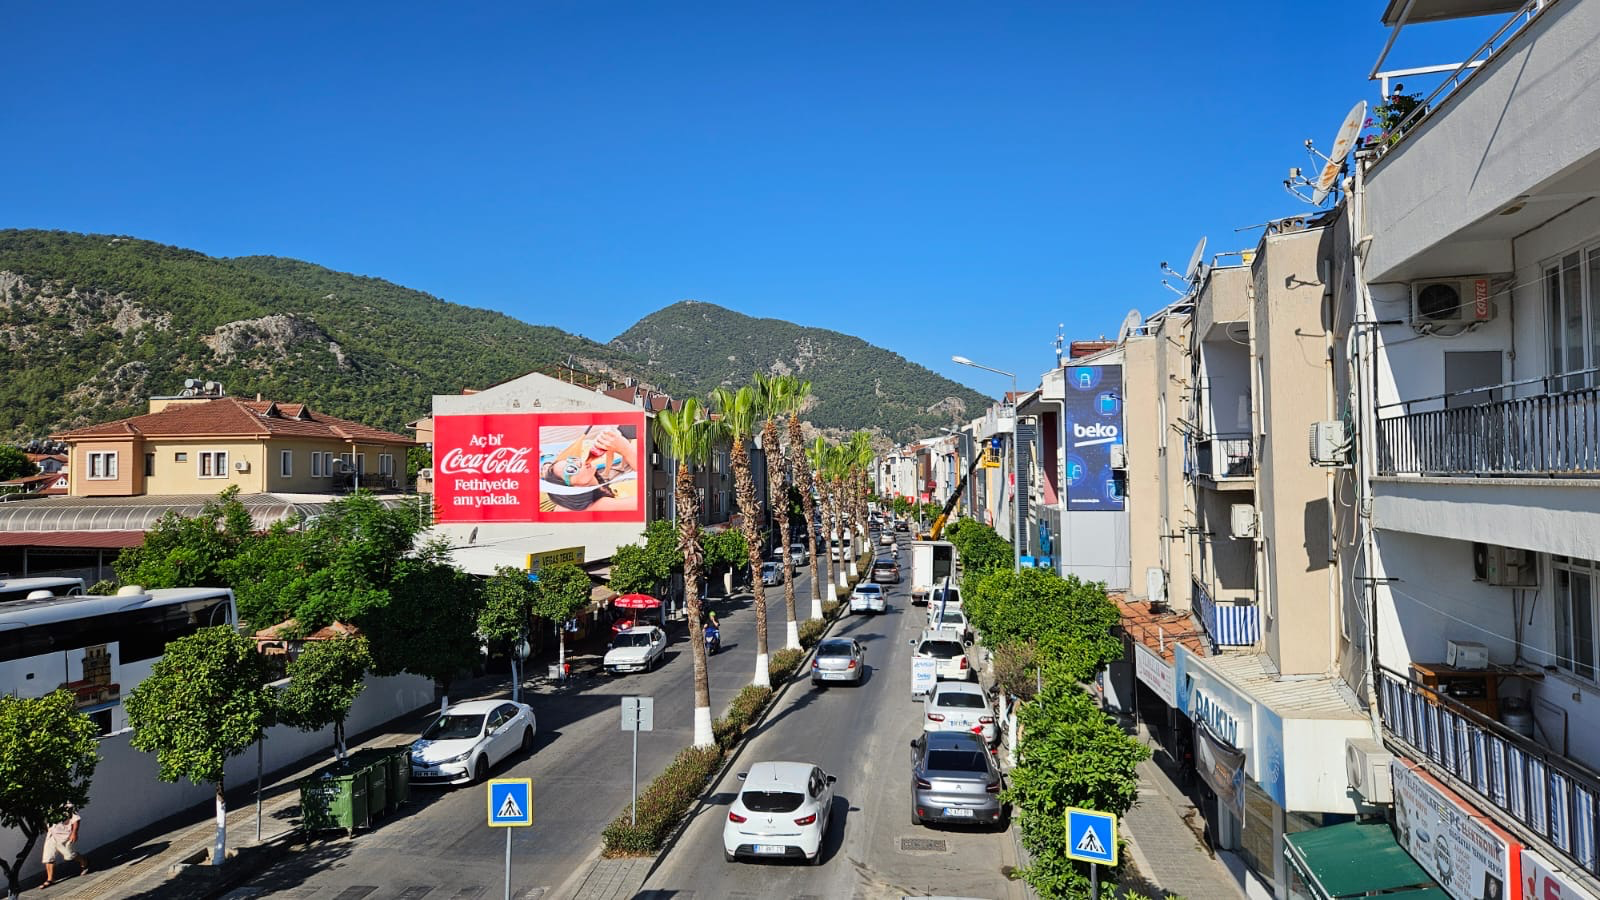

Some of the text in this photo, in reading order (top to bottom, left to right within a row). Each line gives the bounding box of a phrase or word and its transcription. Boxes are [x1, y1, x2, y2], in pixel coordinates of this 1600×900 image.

[1073, 422, 1118, 438] beko
[469, 433, 504, 448] Aç bi'
[440, 447, 533, 475] Coca-Cola
[454, 477, 519, 493] Fethiye'de
[453, 493, 520, 508] anı yakala.
[542, 551, 575, 566] VEGAS TEKEL
[1196, 688, 1238, 749] DAIKIN
